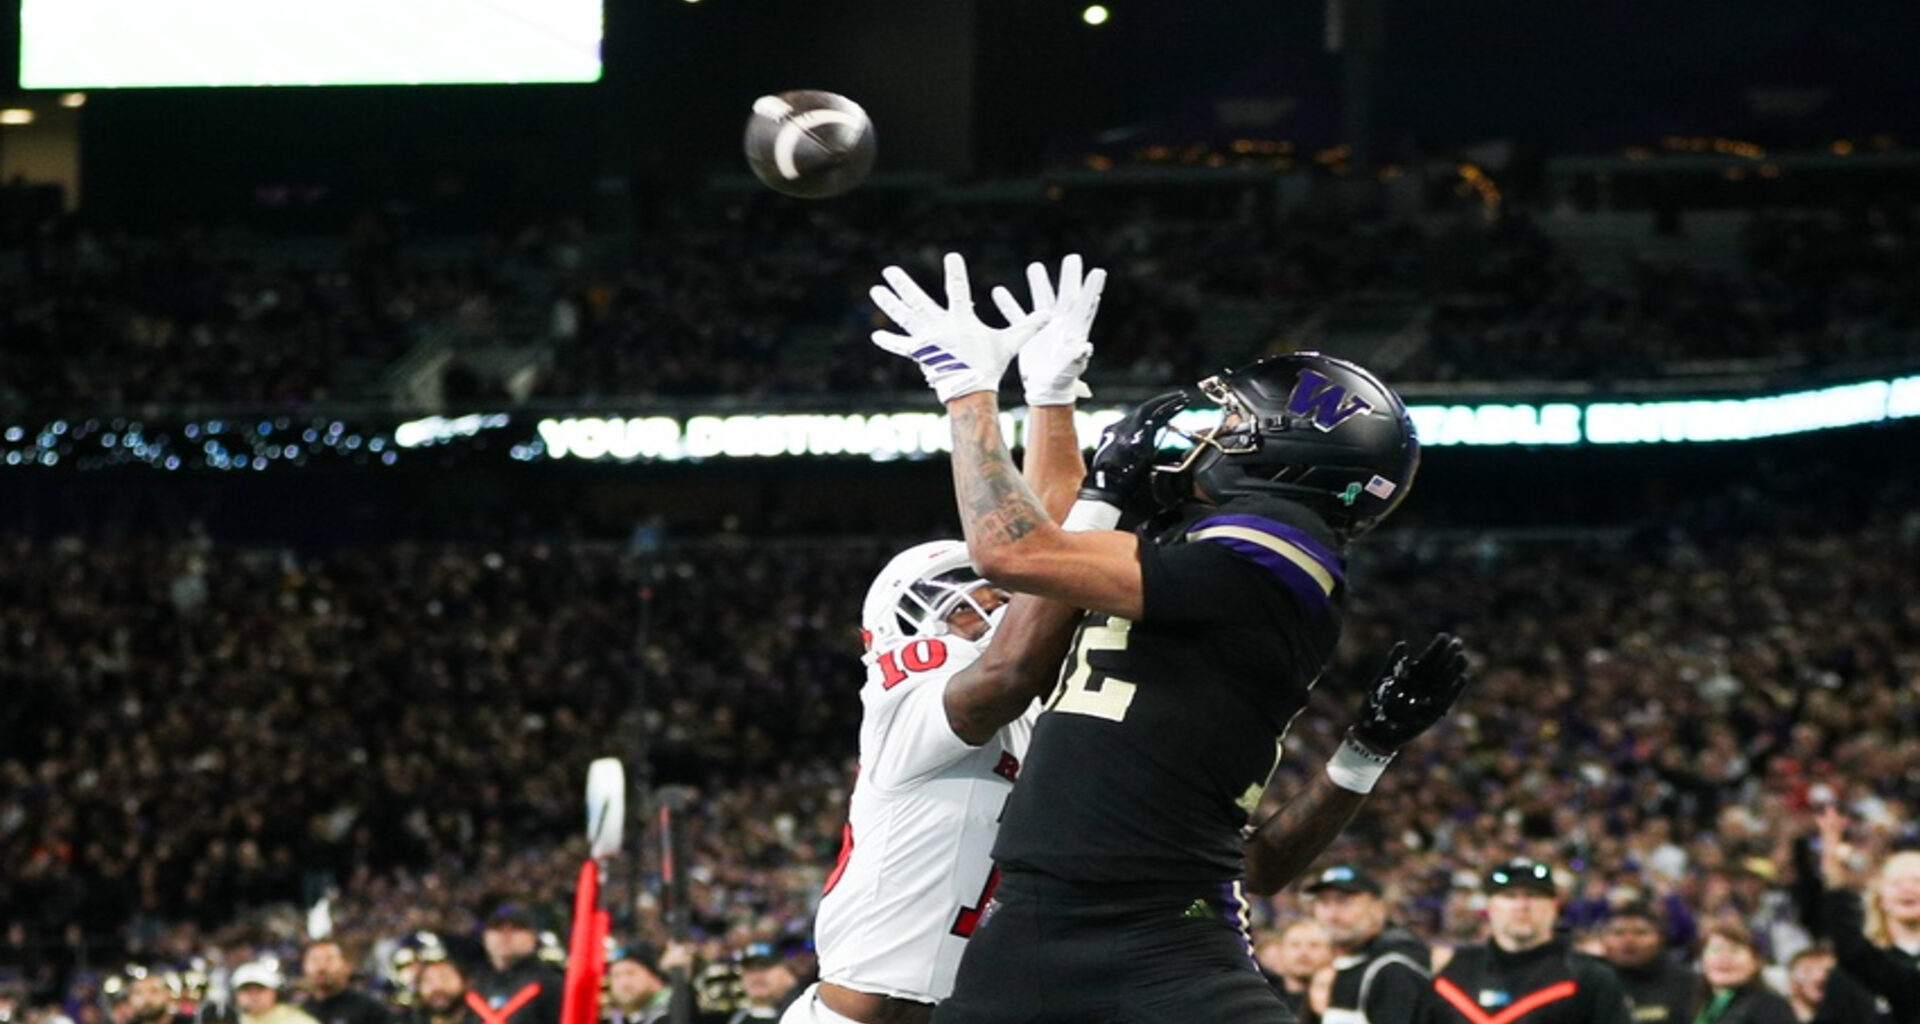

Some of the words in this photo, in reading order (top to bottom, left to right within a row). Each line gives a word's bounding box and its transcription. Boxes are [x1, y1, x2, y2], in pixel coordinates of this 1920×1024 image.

[1285, 367, 1374, 433] W
[538, 416, 680, 461] YOUR
[876, 638, 948, 691] 10
